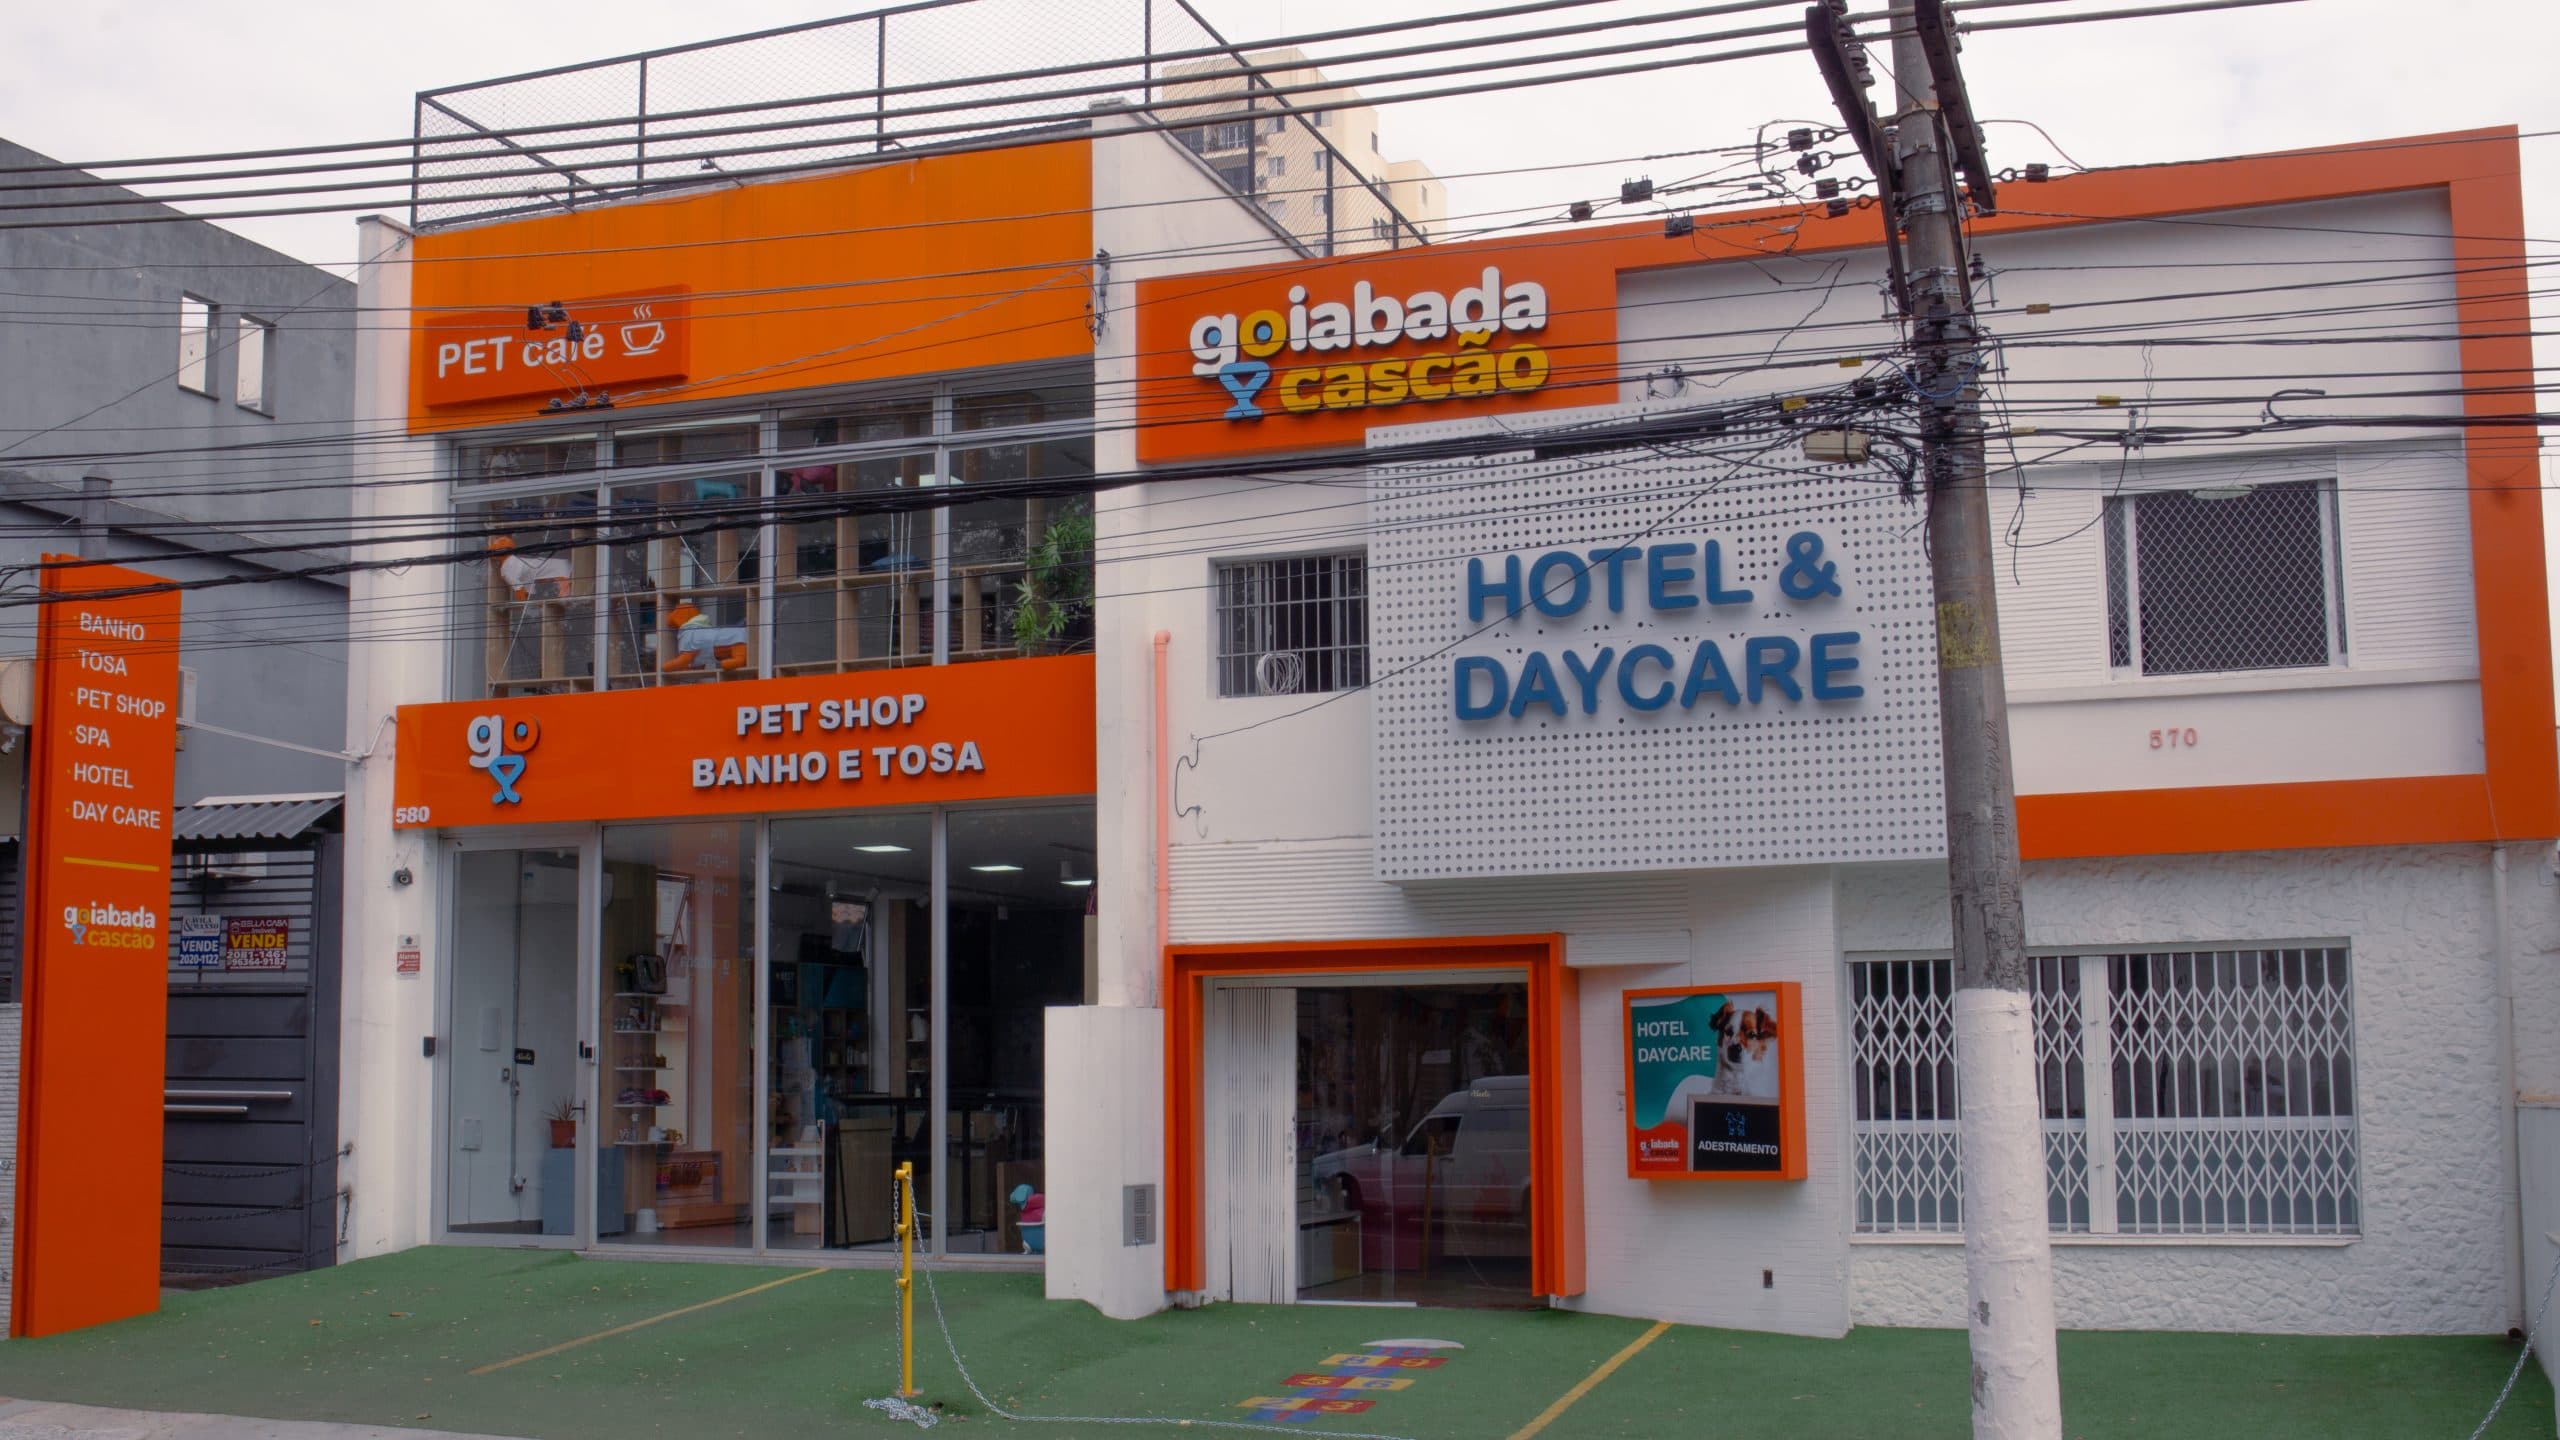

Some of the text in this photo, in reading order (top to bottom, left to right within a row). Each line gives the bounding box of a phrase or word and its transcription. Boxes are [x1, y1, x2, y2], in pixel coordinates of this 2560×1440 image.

[1189, 266, 1548, 377] goiabada
[438, 336, 512, 379] PET
[1280, 329, 1550, 412] cascão
[1467, 530, 1842, 622] HOTEL &
[80, 612, 145, 641] BANHO
[79, 650, 128, 677] TOSA
[1454, 631, 1864, 721] DAYCARE
[77, 687, 166, 719] PET SHOP
[737, 694, 925, 735] PET SHOP
[75, 724, 111, 749] SPA
[2150, 727, 2198, 749] 570
[73, 762, 134, 789] HOTEL
[692, 741, 985, 788] BANHO E TOSA
[72, 800, 161, 829] DAY CARE
[395, 806, 430, 824] 580
[64, 900, 156, 929] goiabada
[88, 926, 156, 949] cascão
[181, 939, 219, 952] VENDE
[231, 934, 285, 948] VENDE
[179, 953, 219, 965] 2020-1122
[1637, 1021, 1689, 1038] HOTEL
[1638, 1046, 1711, 1063] DAYCARE
[1698, 1141, 1778, 1155] ADESTRAMENTO
